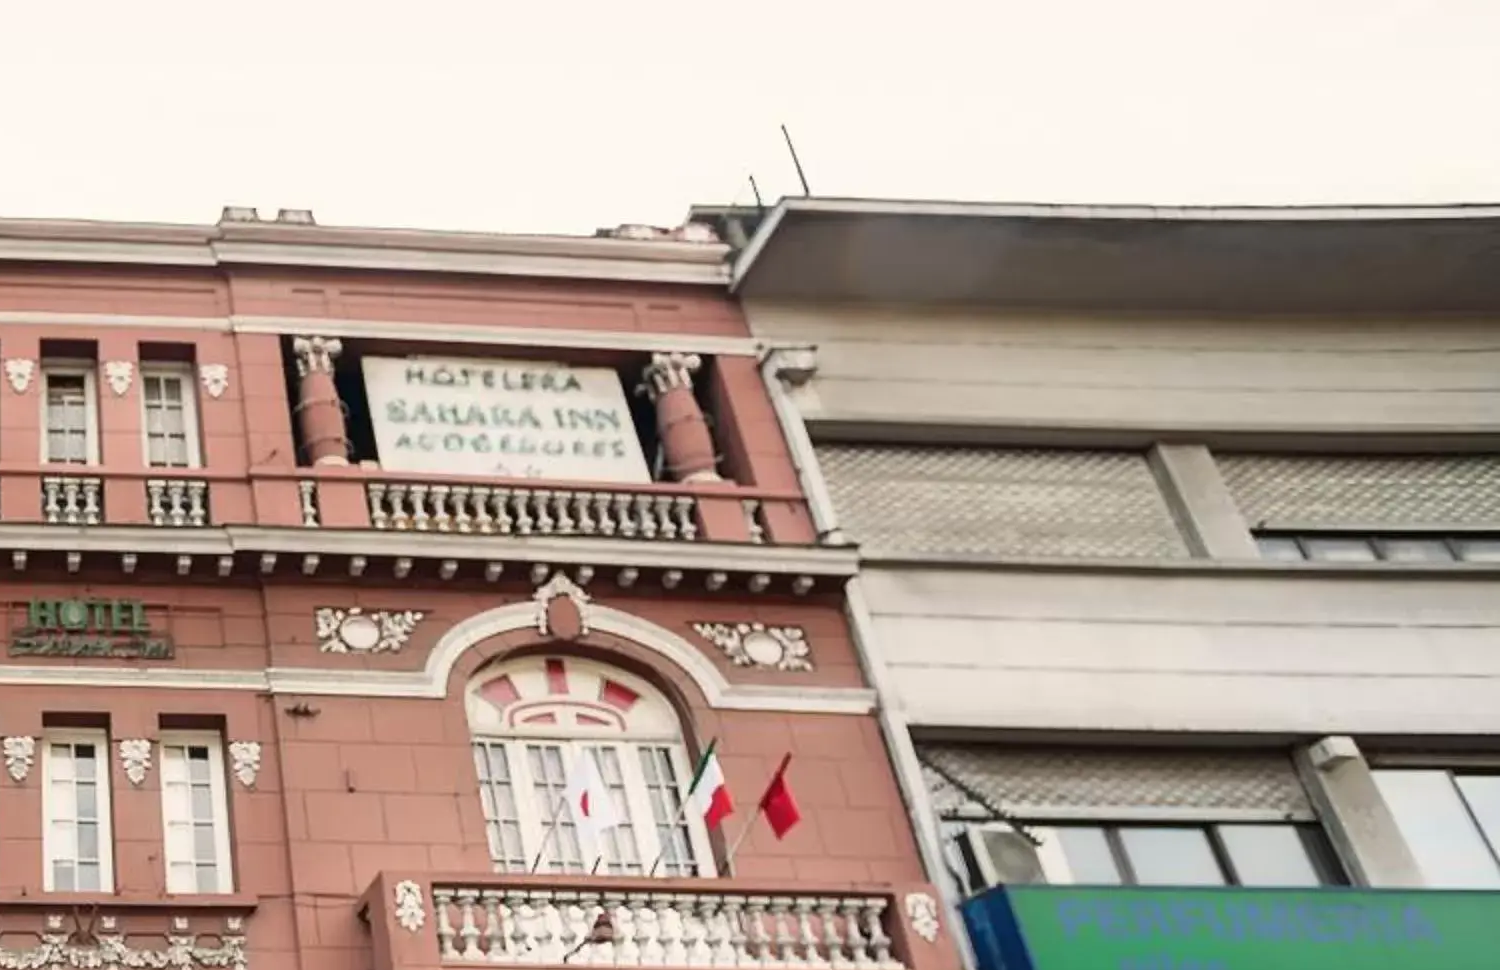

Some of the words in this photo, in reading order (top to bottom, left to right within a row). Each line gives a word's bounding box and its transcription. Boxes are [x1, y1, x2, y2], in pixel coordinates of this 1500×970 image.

[405, 367, 582, 392] HOTELERA
[386, 399, 541, 429] SAHARA
[553, 407, 621, 431] INN
[28, 599, 152, 630] HOTEL
[1054, 896, 1443, 949] PERFUMERIA
